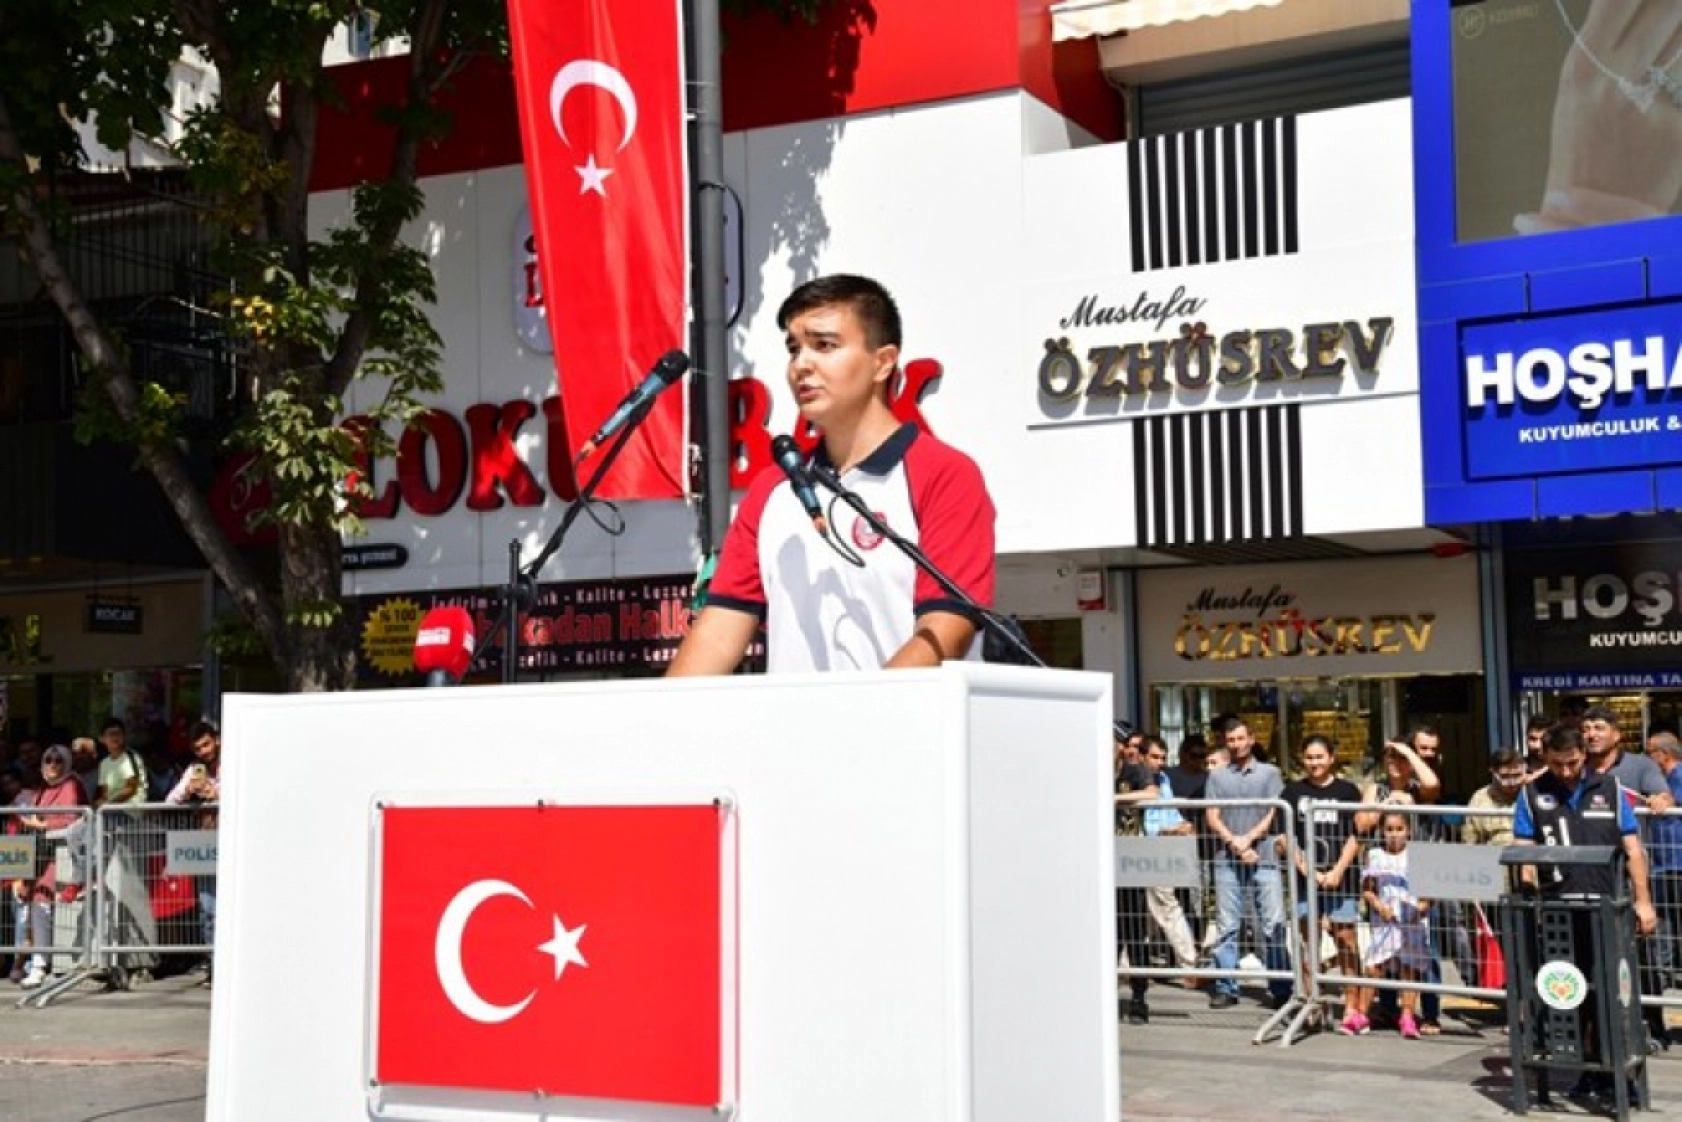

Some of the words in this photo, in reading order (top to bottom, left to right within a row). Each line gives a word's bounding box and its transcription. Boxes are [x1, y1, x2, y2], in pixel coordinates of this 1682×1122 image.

[1059, 285, 1208, 332] Mustafa
[1037, 316, 1394, 398] ÖZHÜSREV
[1518, 416, 1660, 443] KUYUMCULUK
[1186, 584, 1298, 616] Mustafa
[1533, 570, 1682, 627] HOŞ
[1175, 608, 1436, 661] ÖZHÜSREV
[1578, 673, 1655, 687] KARTINA
